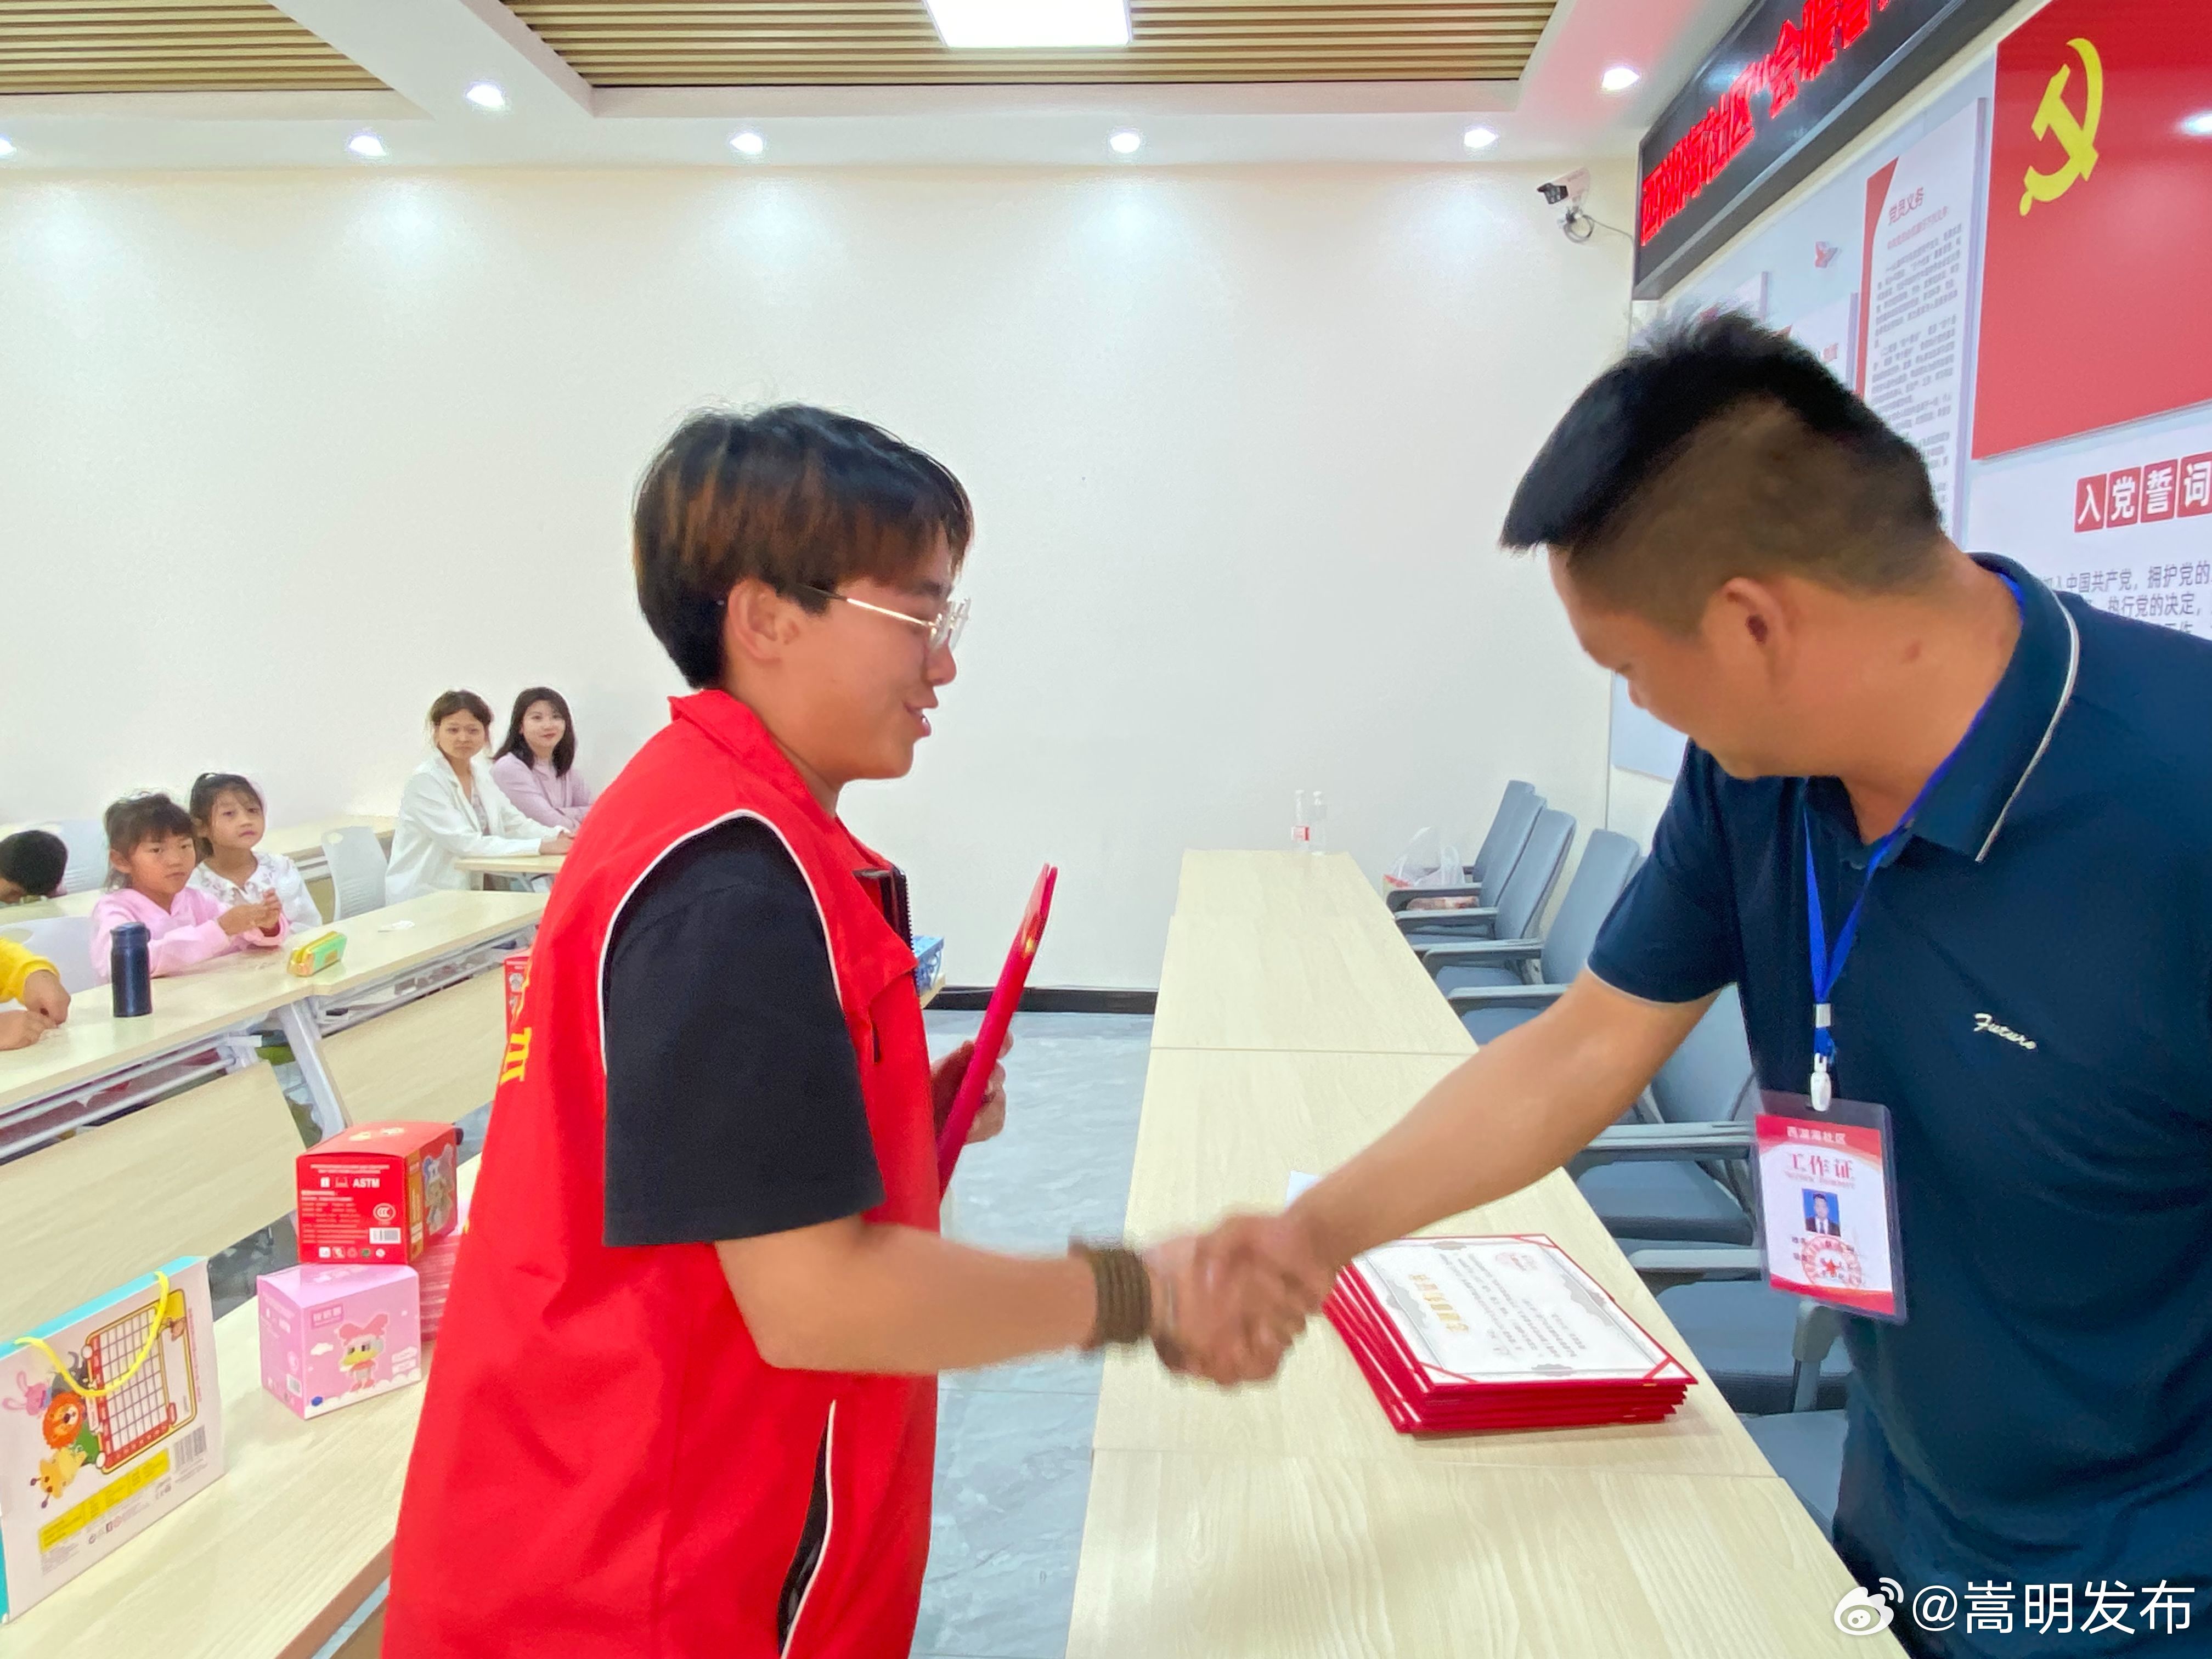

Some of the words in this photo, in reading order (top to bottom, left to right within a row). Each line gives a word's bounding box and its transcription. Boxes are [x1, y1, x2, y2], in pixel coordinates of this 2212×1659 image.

[2077, 462, 2212, 526] 入党誓词
[2042, 559, 2210, 593] 入中国共产党，拥护党的
[1788, 1153, 1855, 1180] 工作证
[353, 1177, 380, 1188] ASTM
